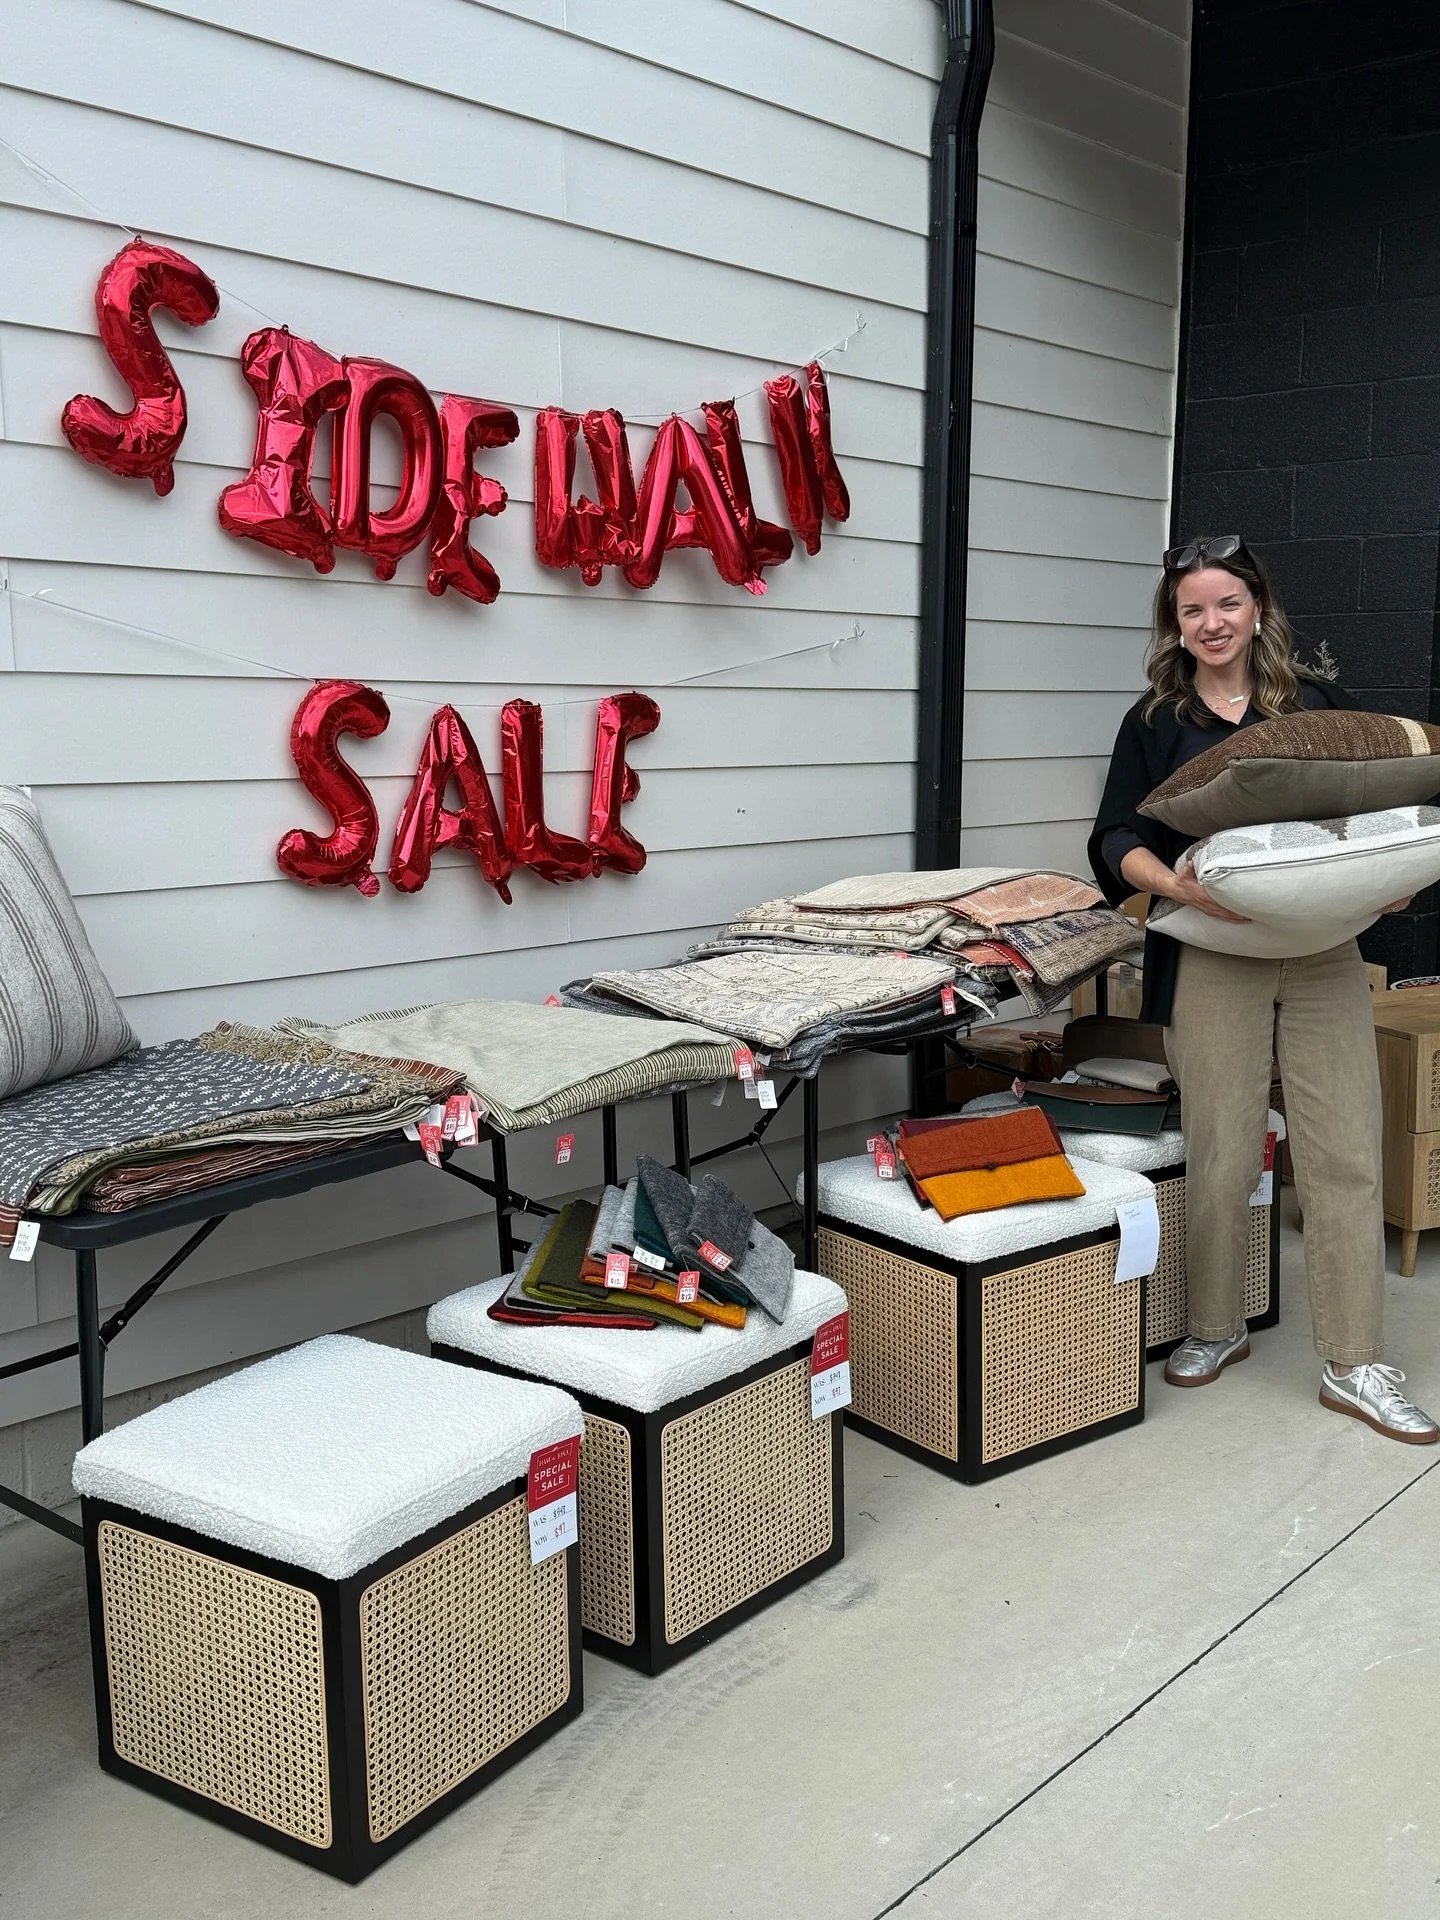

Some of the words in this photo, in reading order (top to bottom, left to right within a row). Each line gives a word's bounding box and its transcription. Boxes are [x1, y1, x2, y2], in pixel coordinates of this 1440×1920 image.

[277, 679, 661, 904] SALE
[610, 1260, 626, 1268] SALE
[682, 1276, 695, 1284] SALE
[815, 1333, 844, 1352] SPECIAL
[820, 1345, 839, 1360] SALE
[813, 1377, 826, 1389] WAS
[813, 1394, 827, 1406] NOW
[533, 1460, 573, 1483] SPECIAL
[541, 1474, 565, 1492] SALE
[532, 1514, 547, 1528] WAS
[534, 1534, 549, 1547] NOW
